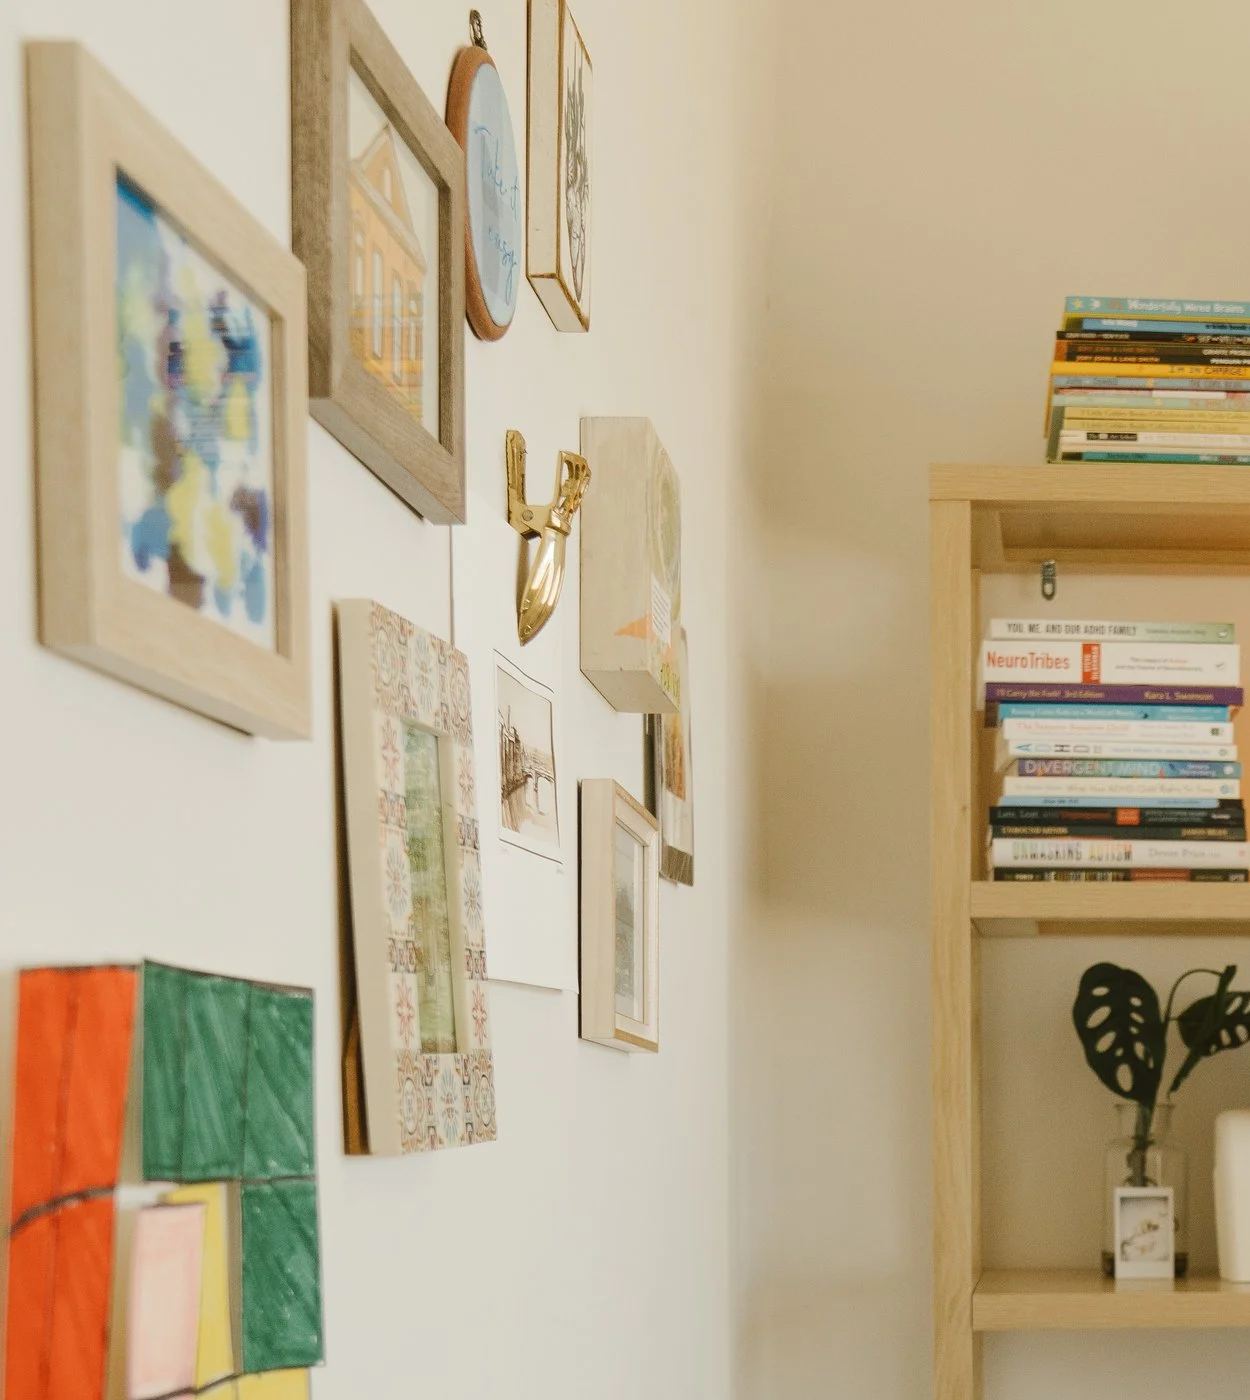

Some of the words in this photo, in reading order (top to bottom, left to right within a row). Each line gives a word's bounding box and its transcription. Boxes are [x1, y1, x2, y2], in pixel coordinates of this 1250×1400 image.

[1046, 624, 1062, 635] AND
[1065, 625, 1081, 635] OUR
[1084, 625, 1105, 636] ADHD
[1108, 625, 1137, 637] FAMILY
[986, 650, 1071, 671] NeuroTribes
[1024, 759, 1113, 775] DIVERGENT
[1118, 761, 1160, 776] MIND
[1013, 841, 1082, 861] UNMASKING
[1089, 842, 1132, 862] AUTISM
